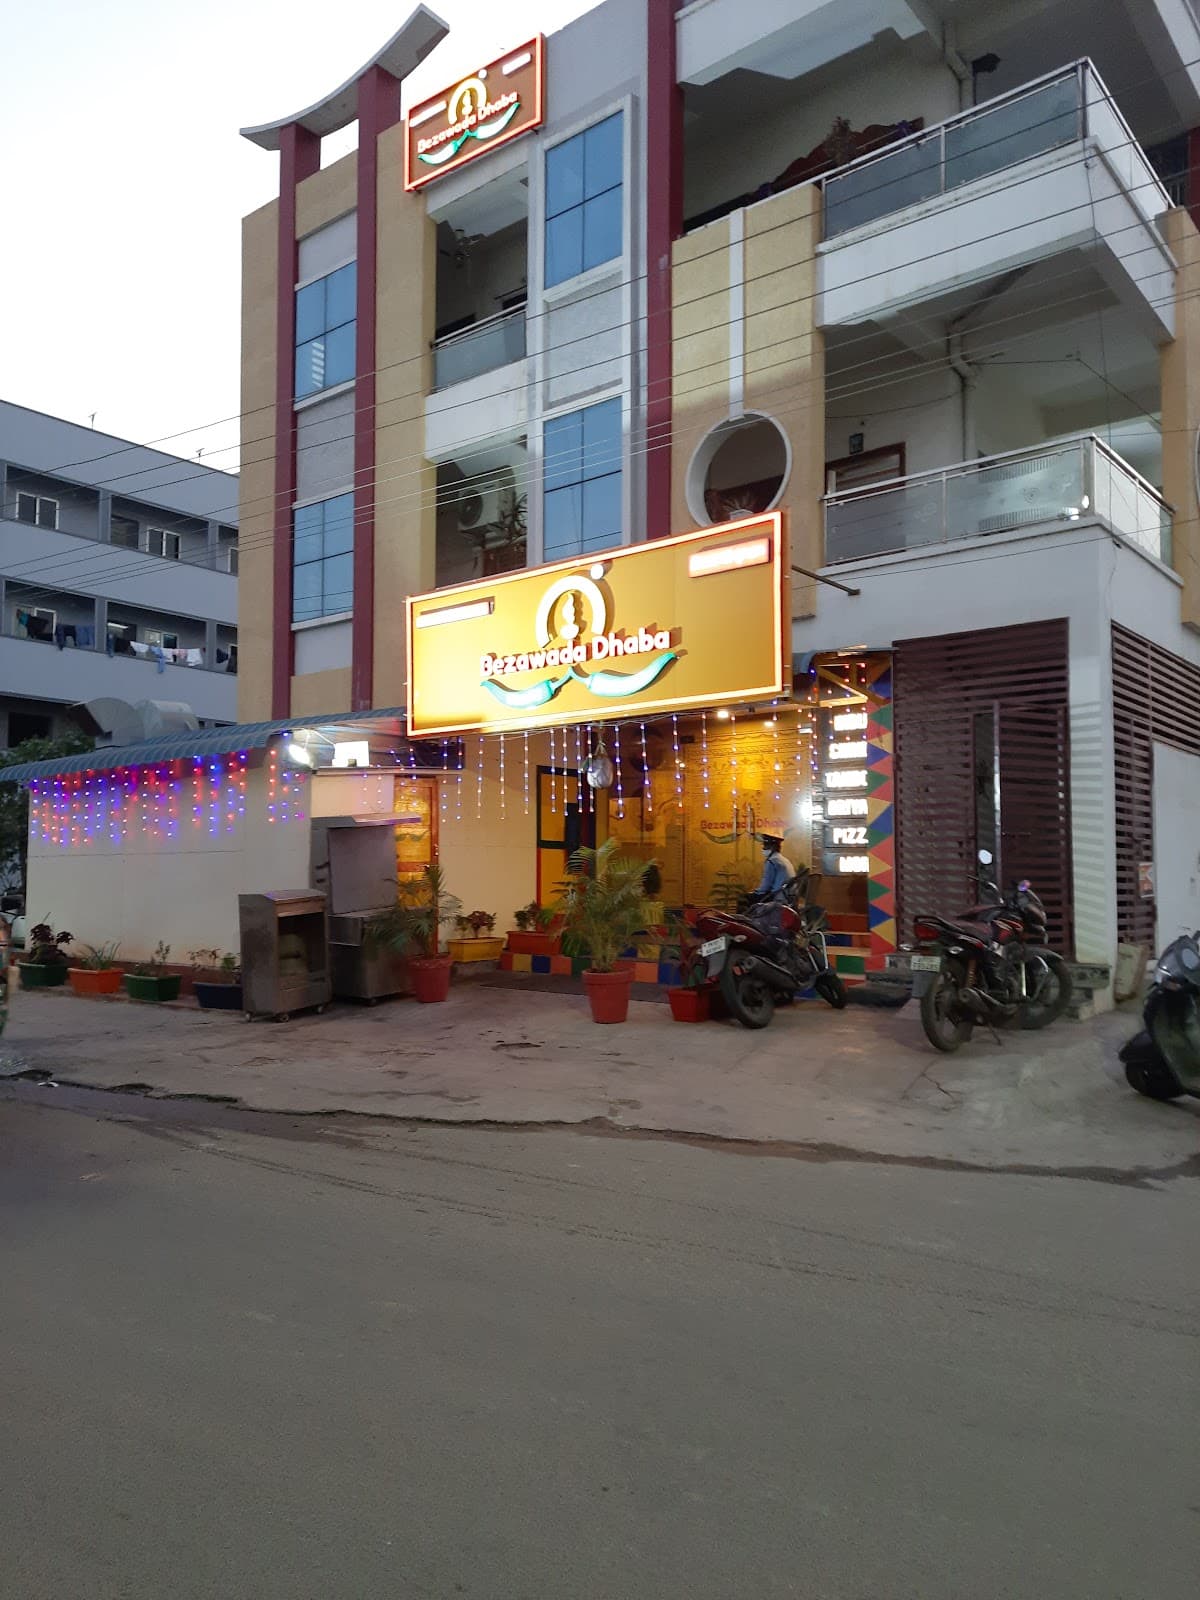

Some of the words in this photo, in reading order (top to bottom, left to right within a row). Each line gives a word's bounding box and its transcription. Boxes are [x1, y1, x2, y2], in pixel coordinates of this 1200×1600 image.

[417, 114, 477, 154] Bezawada
[477, 90, 518, 121] Dhaba
[480, 639, 587, 676] Bezawada
[591, 628, 670, 659] Dhaba
